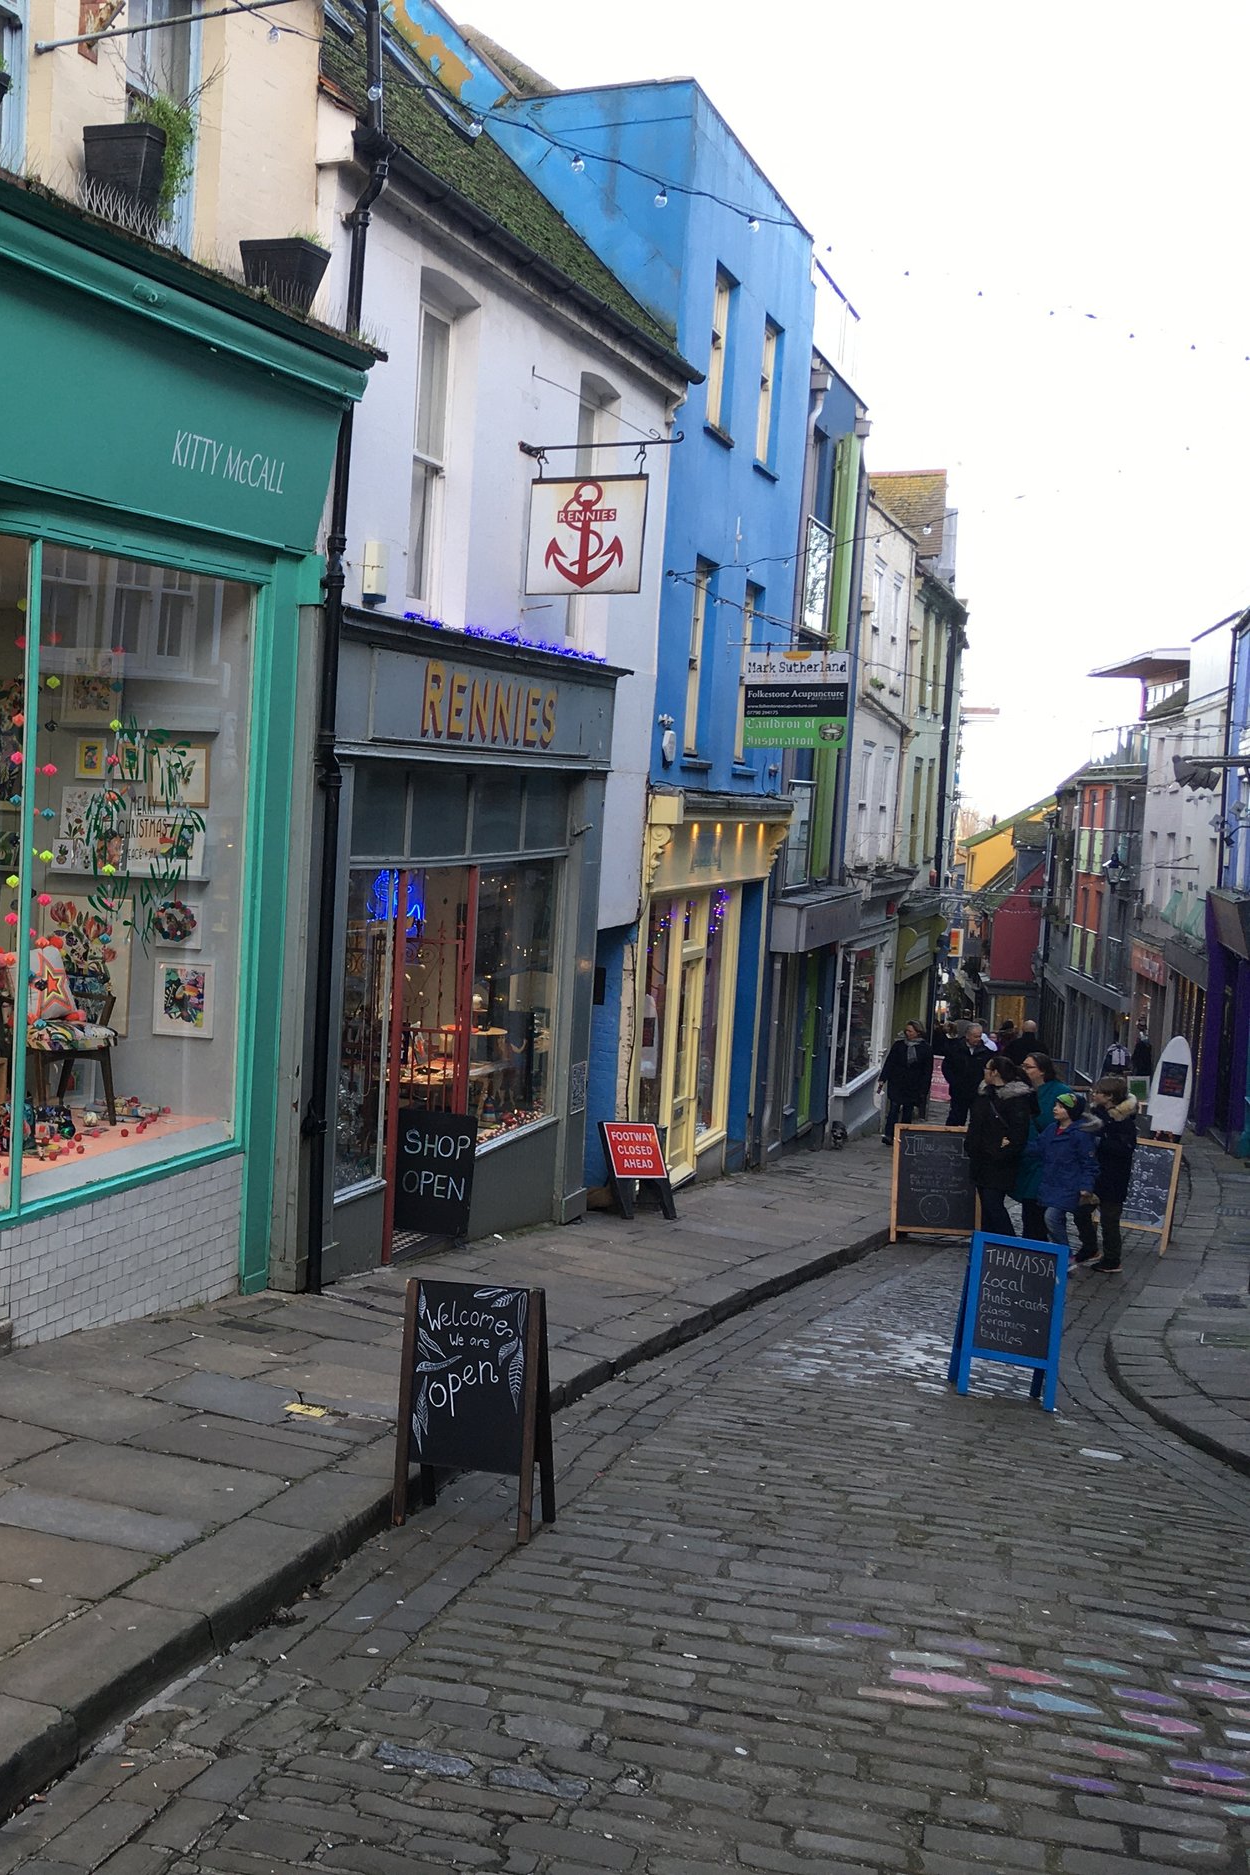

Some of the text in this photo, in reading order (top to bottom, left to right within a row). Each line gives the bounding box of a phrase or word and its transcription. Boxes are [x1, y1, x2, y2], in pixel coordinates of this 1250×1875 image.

[172, 430, 285, 494] KITTY McCALL
[559, 510, 616, 522] RENNIES
[748, 661, 847, 674] Mark Sutherland
[420, 658, 558, 749] RENNIES
[747, 689, 844, 700] Folkestone Acupuncture
[745, 718, 816, 729] Cauldron of
[746, 735, 814, 747] Inspiration
[130, 795, 158, 815] MERRY
[117, 818, 168, 839] CHRISTMAS
[404, 1128, 471, 1161] SHOP
[611, 1130, 653, 1143] FOOTWAY
[617, 1144, 653, 1156] CLOSED
[623, 1158, 654, 1169] AHEAD
[402, 1170, 465, 1201] OPEN
[986, 1248, 1055, 1278] THALASSA
[982, 1271, 1025, 1293] Local
[426, 1300, 514, 1338] Welcome
[449, 1333, 490, 1349] We are
